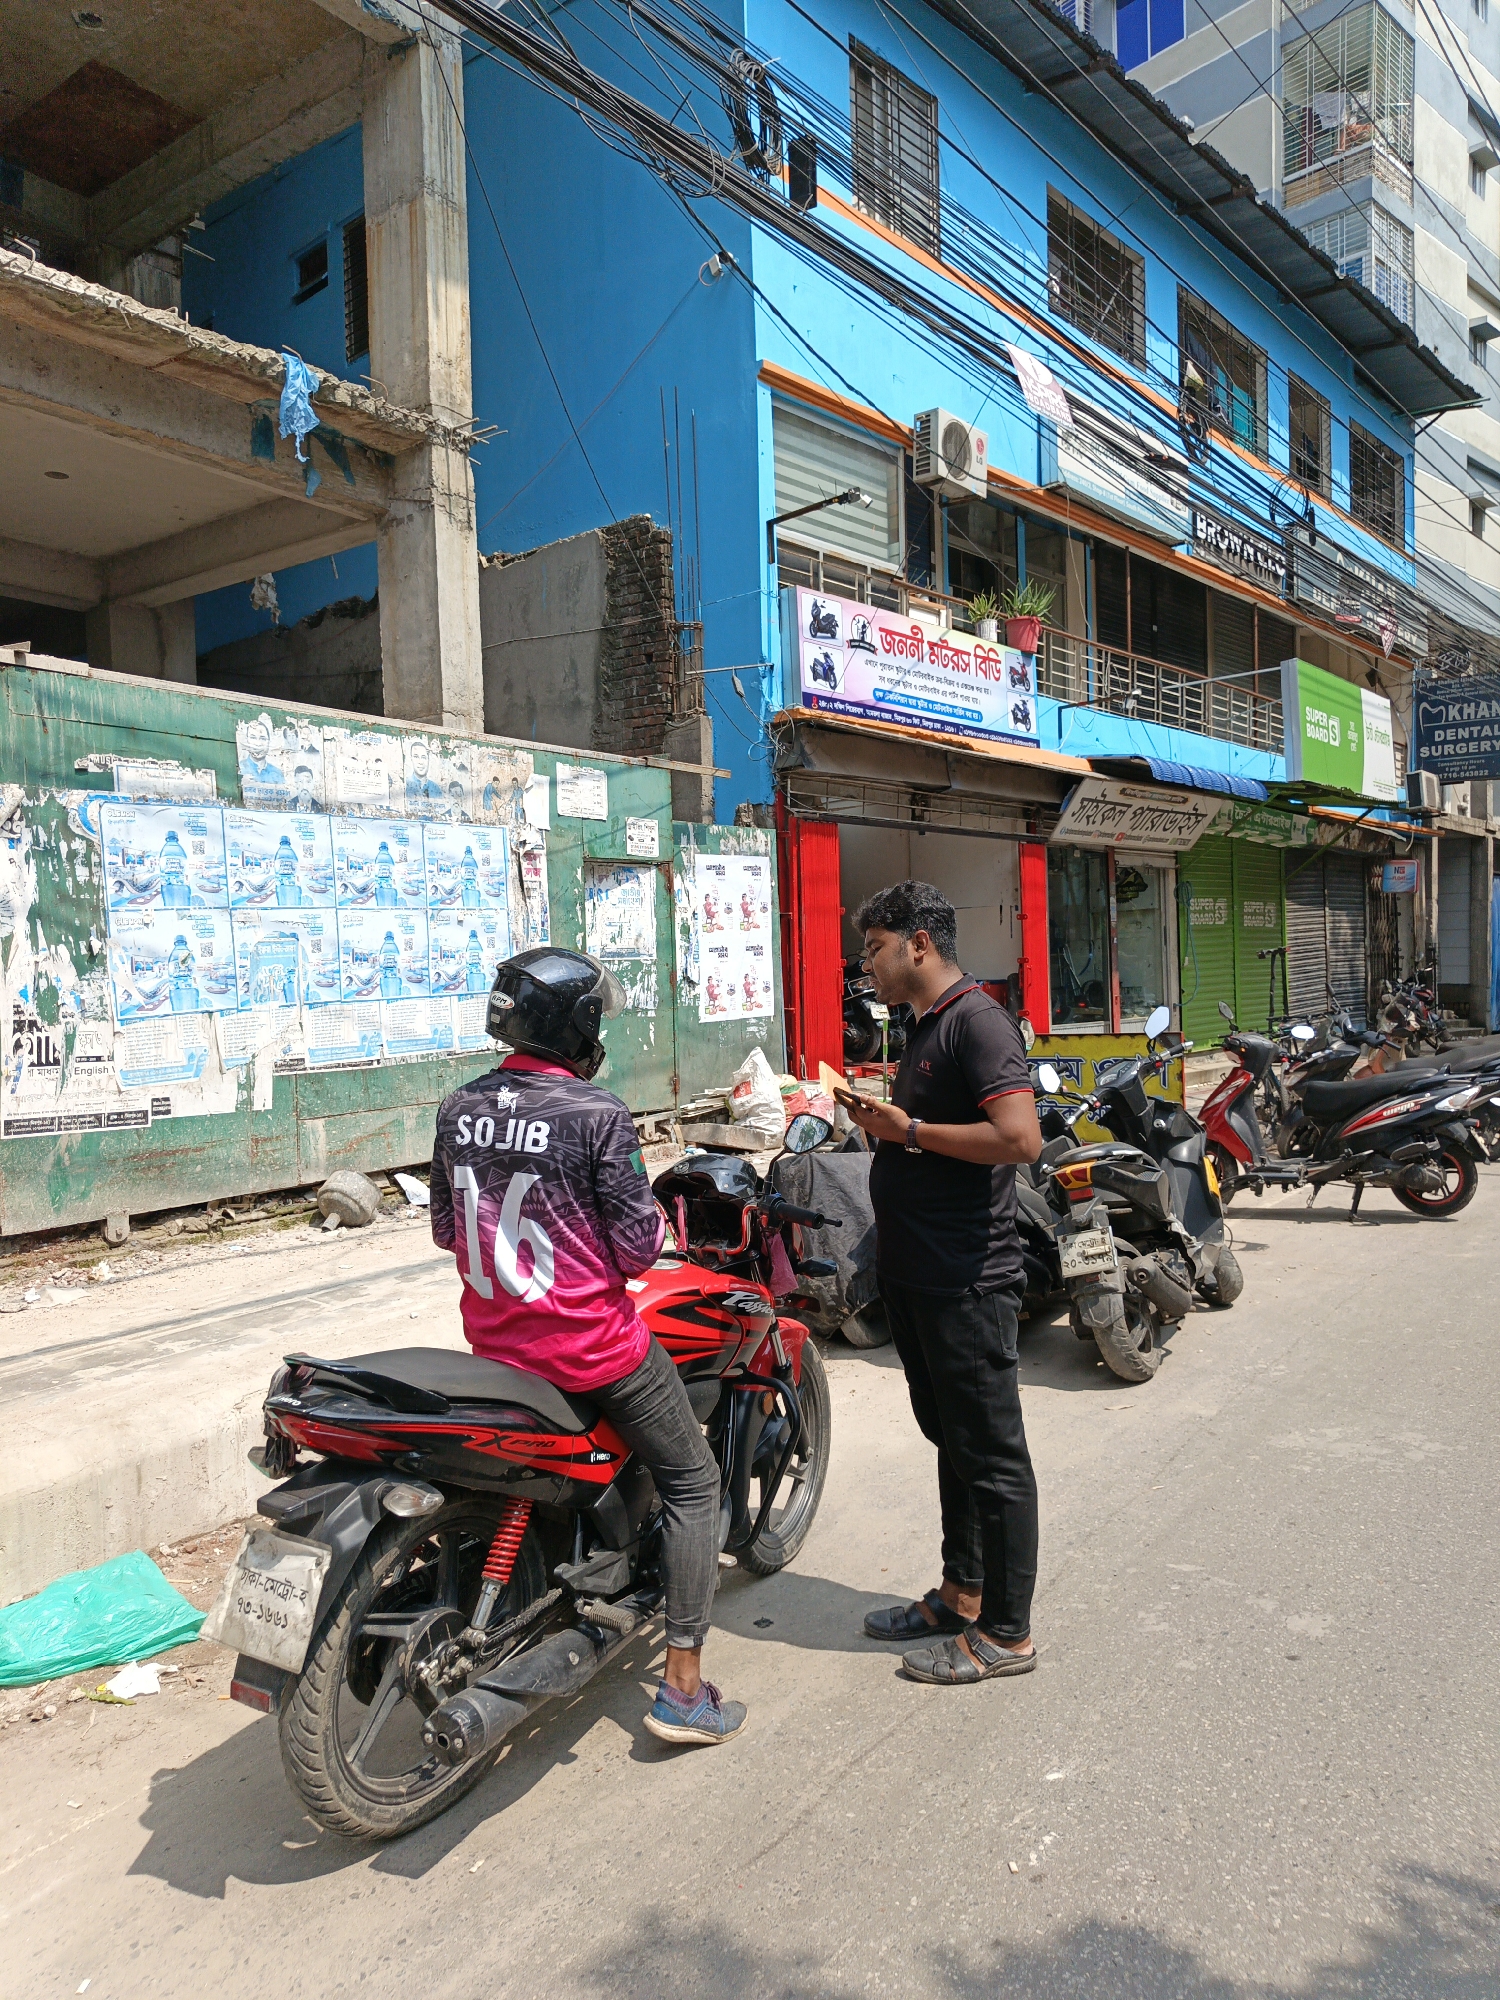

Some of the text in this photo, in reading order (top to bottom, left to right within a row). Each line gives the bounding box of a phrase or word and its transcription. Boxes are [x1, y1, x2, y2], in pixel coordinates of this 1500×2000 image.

[879, 625, 924, 663] জননী
[927, 637, 972, 676] মটরস
[974, 643, 1002, 682] বিডি
[1305, 705, 1328, 727] SUPER
[1306, 723, 1329, 743] BOARD
[1435, 723, 1500, 742] DENTAL
[1420, 739, 1500, 758] SURGERY
[106, 808, 136, 818] CLEMON
[1071, 788, 1133, 827] সাইকেল
[1129, 803, 1208, 835] প্যারাডাইস
[1190, 898, 1215, 911] SUPER
[1190, 912, 1215, 925] BOARD
[74, 1066, 109, 1077] English
[454, 1165, 555, 1303] 16
[596, 1452, 611, 1461] Hero
[238, 1597, 288, 1629] ৭৩-১৬৬১
